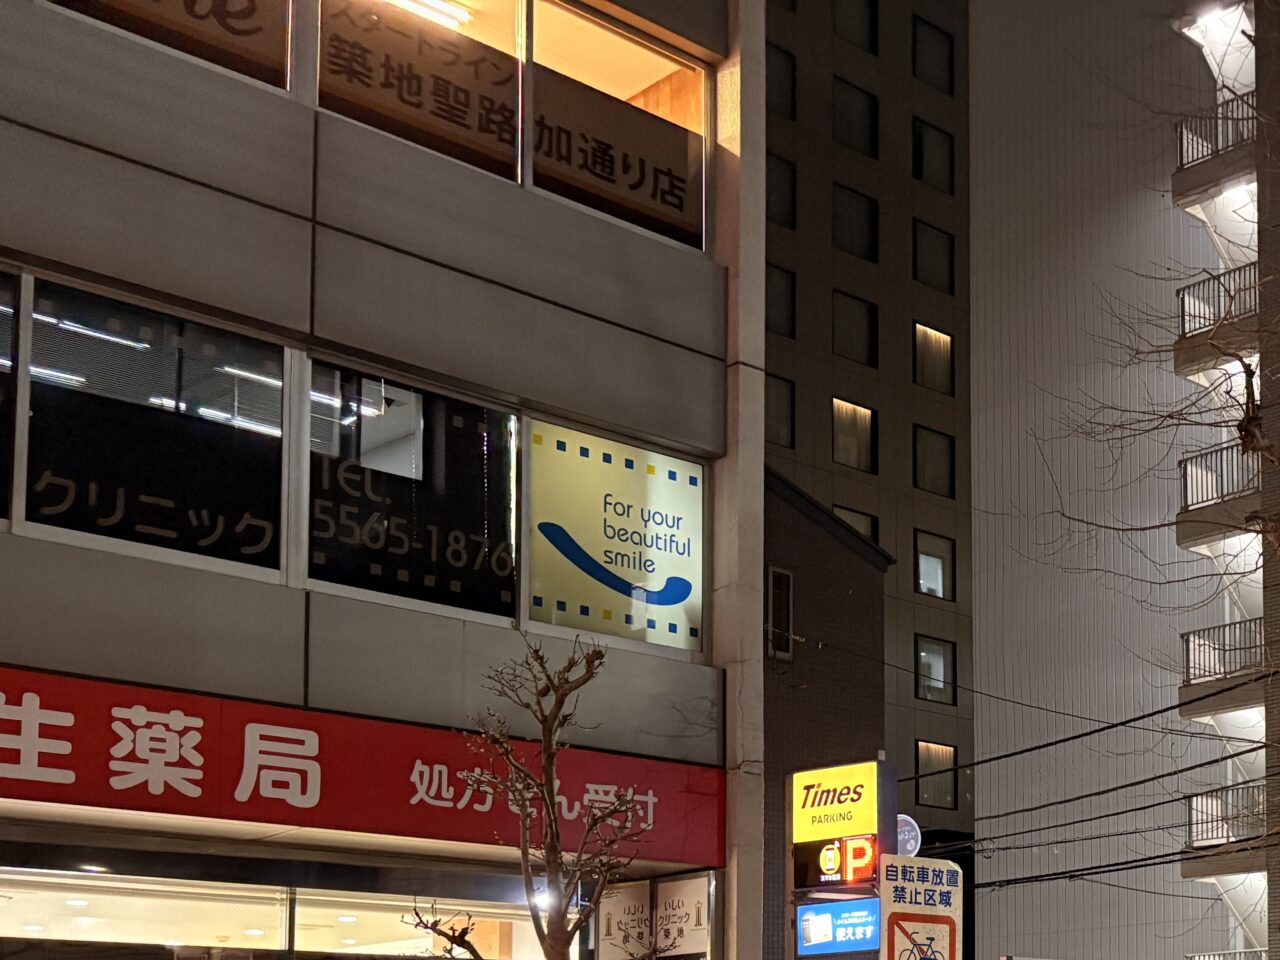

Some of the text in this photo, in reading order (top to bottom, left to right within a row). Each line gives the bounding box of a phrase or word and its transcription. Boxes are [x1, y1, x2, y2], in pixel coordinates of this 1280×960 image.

[327, 33, 687, 213] 築地聖路加通り店
[32, 470, 274, 555] クリニック
[604, 493, 683, 530] for your
[313, 498, 513, 577] 5565-1876
[604, 517, 690, 557] beautiful
[604, 550, 655, 573] smile
[0, 692, 322, 809] 生薬局
[801, 783, 864, 809] Times
[811, 811, 853, 826] PARKING
[846, 839, 873, 881] P
[885, 863, 960, 888] 自転車放置
[664, 899, 685, 912] いしい
[892, 885, 953, 908] 禁止区域
